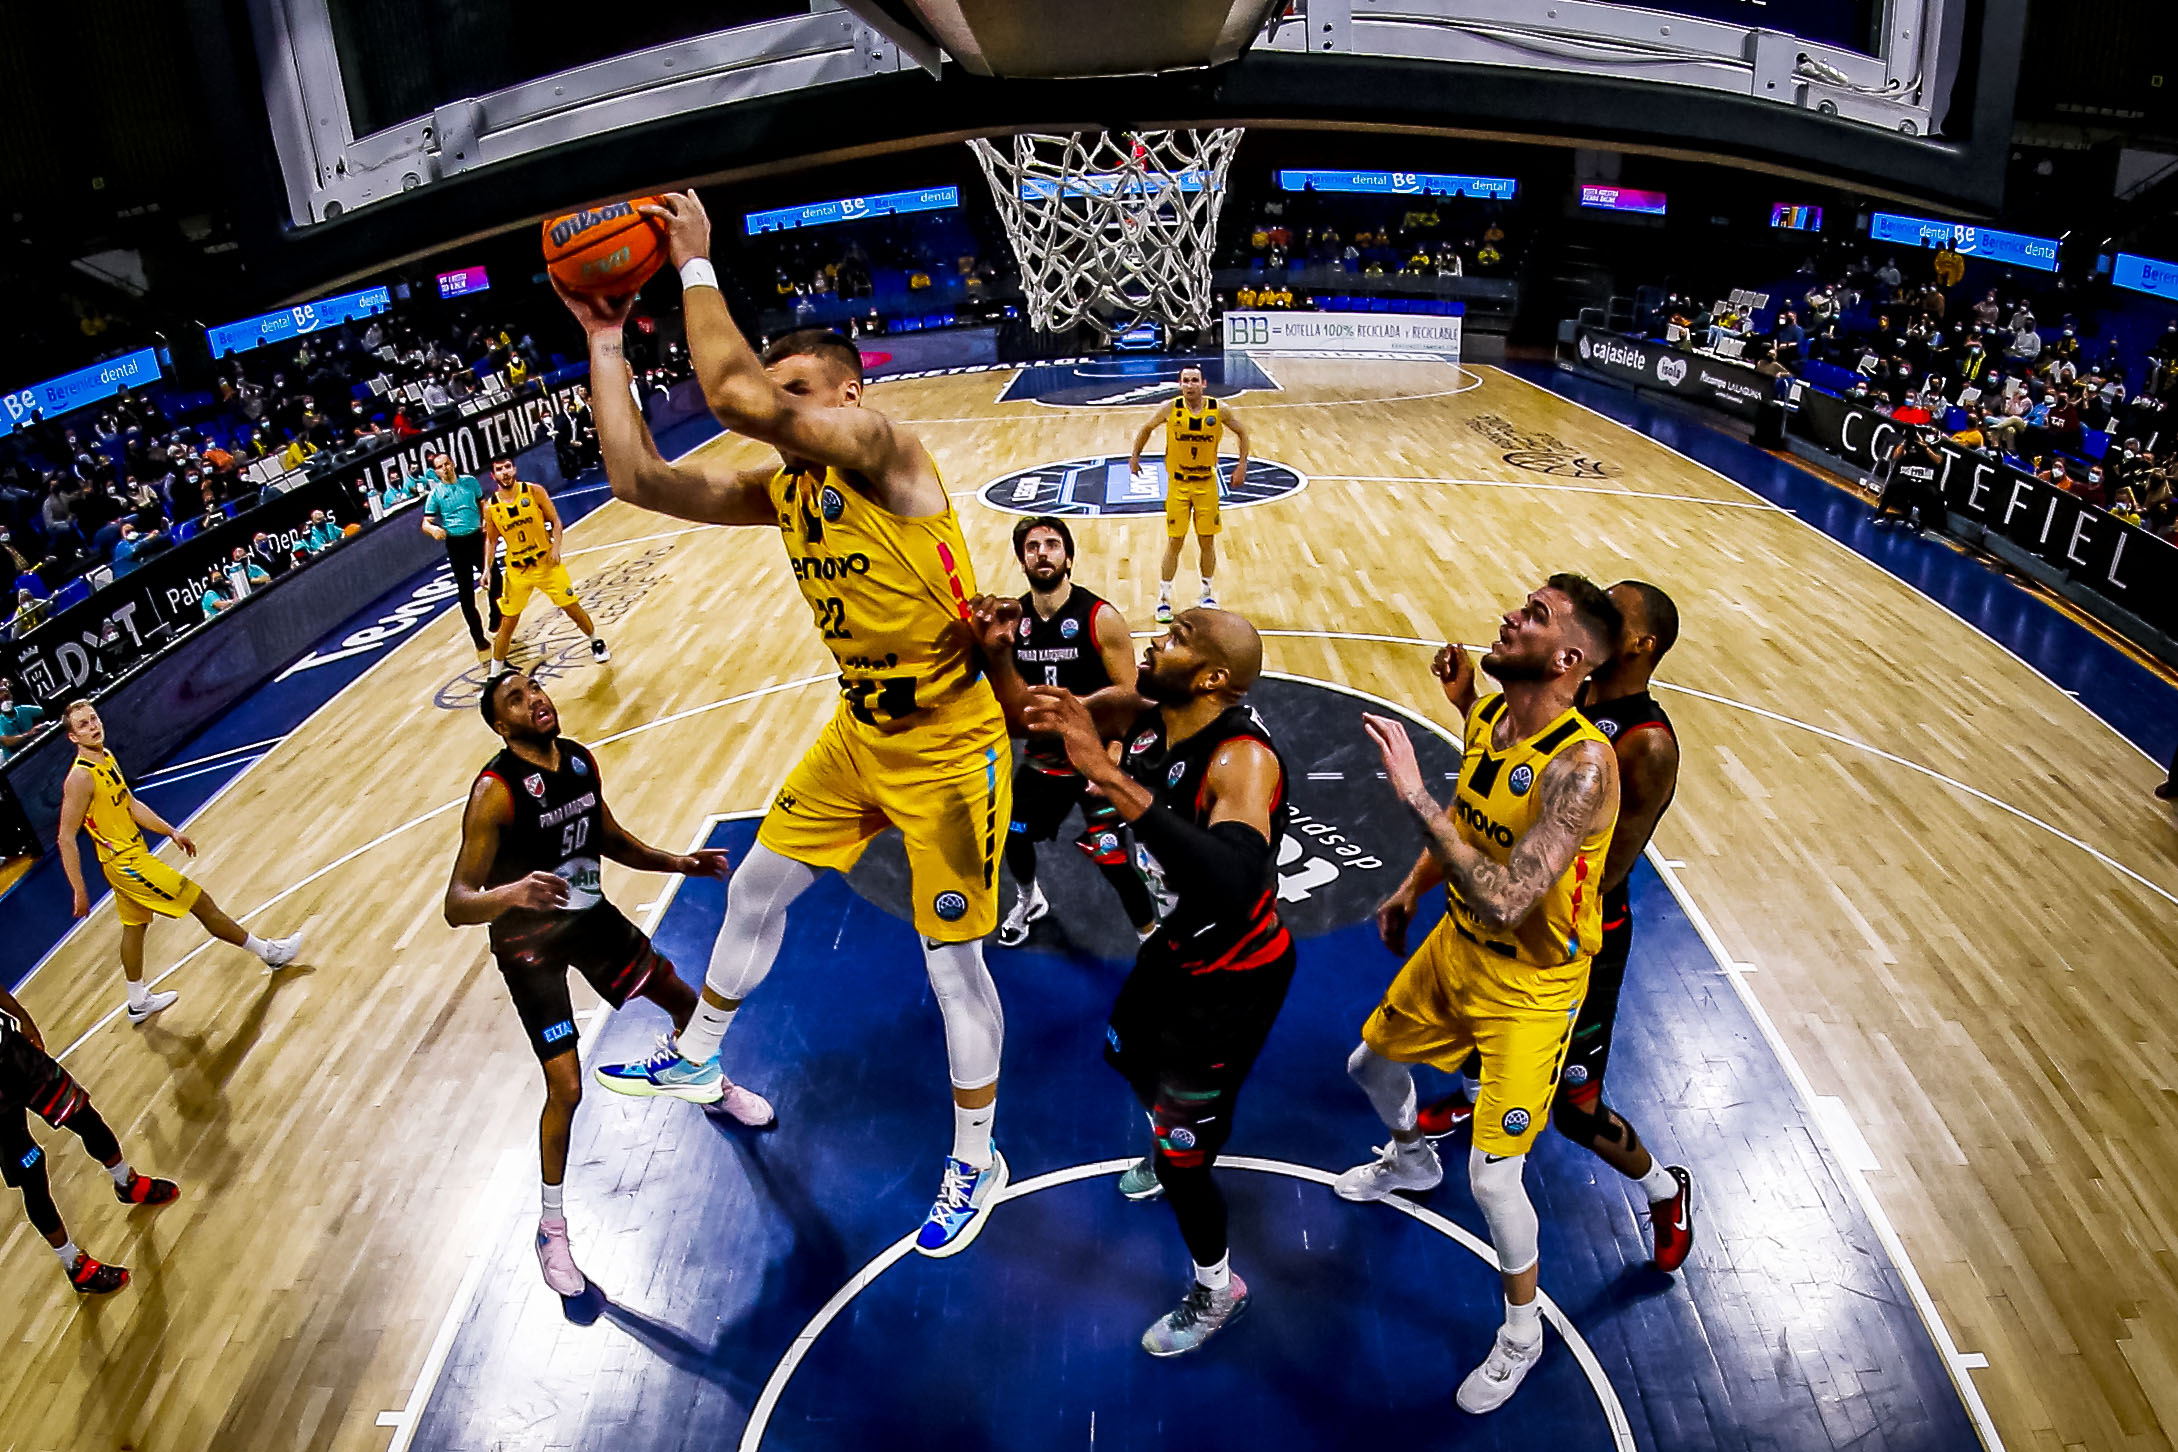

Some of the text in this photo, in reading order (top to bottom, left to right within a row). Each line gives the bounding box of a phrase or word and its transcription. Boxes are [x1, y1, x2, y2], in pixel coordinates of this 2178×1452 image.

[1391, 172, 1417, 187] Be
[802, 204, 837, 218] dental
[840, 197, 866, 215] Be
[920, 190, 954, 202] dental
[550, 201, 634, 248] Wilson
[1919, 224, 1950, 240] dental
[1954, 224, 1976, 245] Be
[2025, 242, 2056, 259] denta
[261, 314, 291, 333] dental
[291, 303, 315, 327] Be
[1228, 316, 1270, 345] BB
[1285, 323, 1321, 338] BOTELLA
[1323, 323, 1355, 338] 100%
[1357, 324, 1401, 339] RECICLADA
[1411, 325, 1458, 342] RECICLABLE
[1592, 341, 1646, 371] cajasiete
[3, 358, 139, 420] Be Berenice dental
[1174, 431, 1215, 443] Lenovo
[1190, 446, 1199, 461] 9
[1841, 411, 2129, 590] COTEFIEL
[502, 516, 533, 532] Lenovo
[518, 530, 526, 542] 0
[790, 552, 871, 581] enovo
[815, 596, 853, 639] 22
[560, 816, 590, 858] 50
